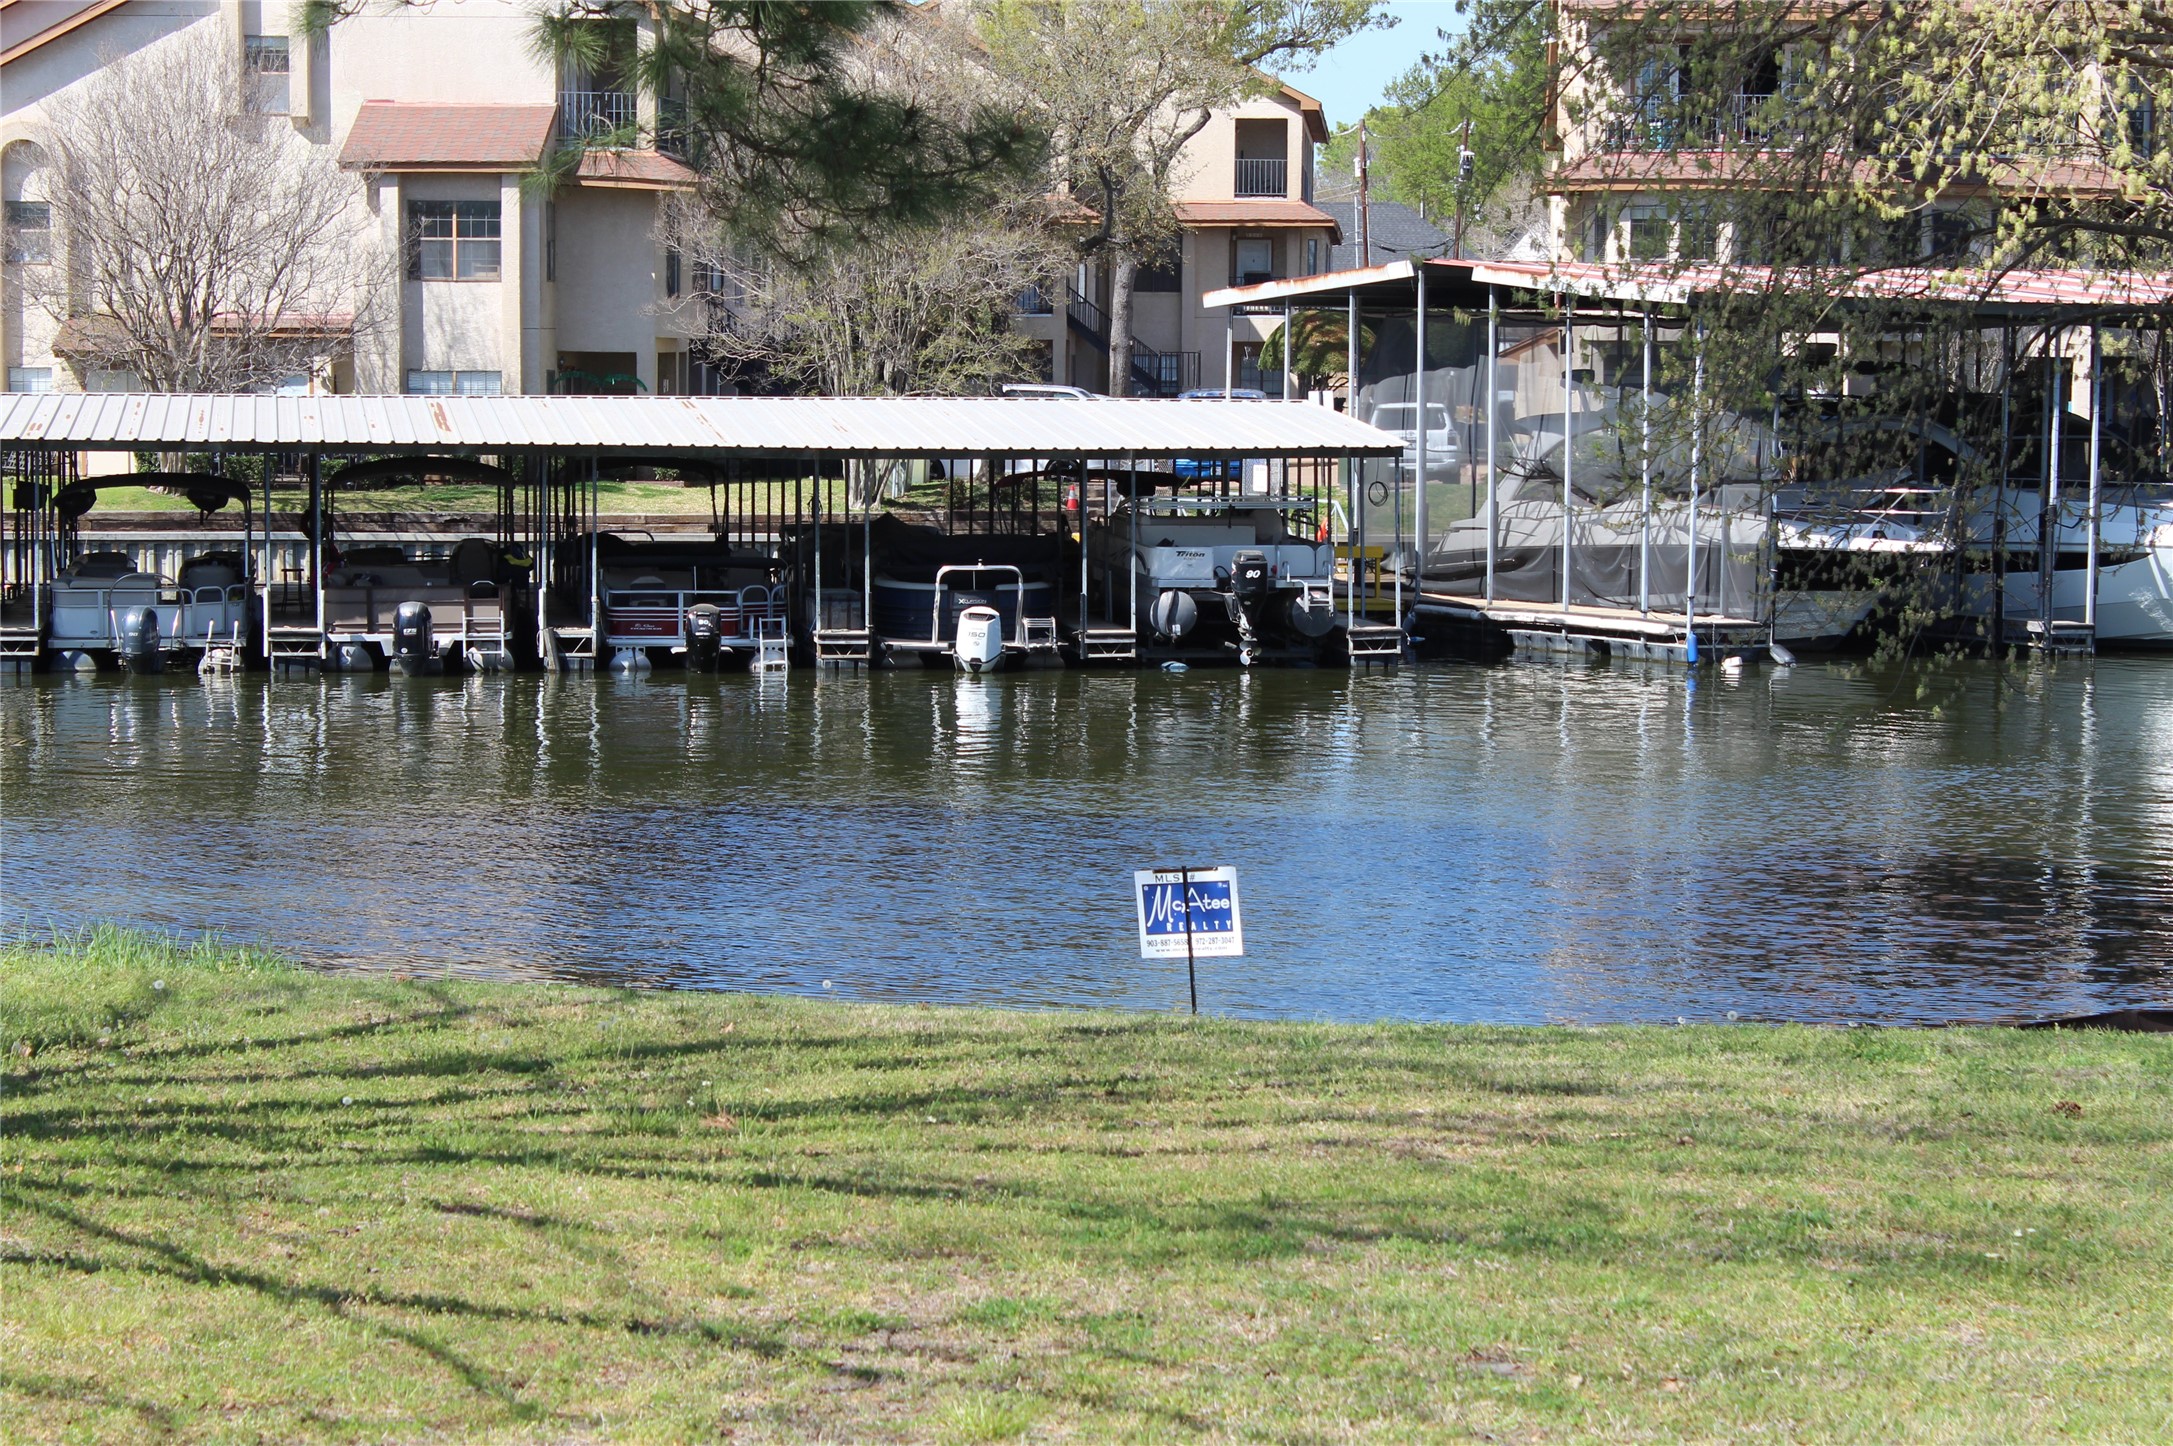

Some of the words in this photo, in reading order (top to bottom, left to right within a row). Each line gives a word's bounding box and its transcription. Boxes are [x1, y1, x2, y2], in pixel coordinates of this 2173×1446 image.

[1246, 570, 1260, 578] 90
[1155, 874, 1180, 883] MLS
[1147, 885, 1230, 927] McAtee
[1166, 920, 1231, 932] REALTY
